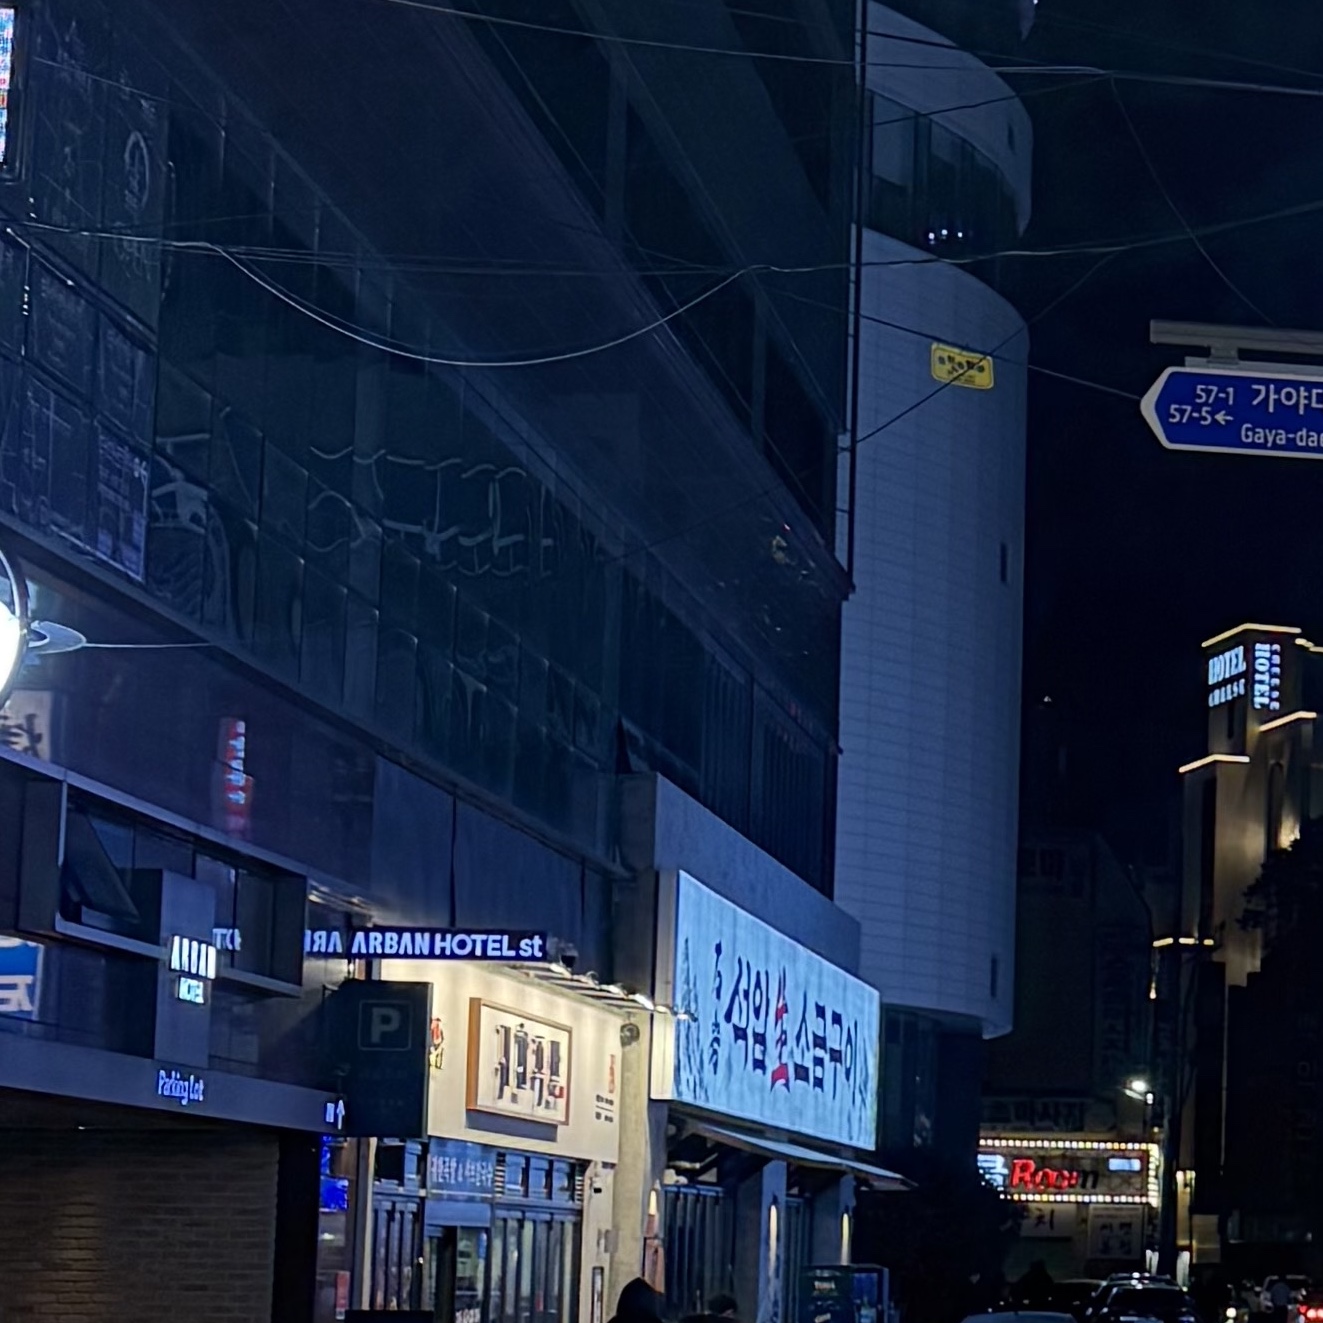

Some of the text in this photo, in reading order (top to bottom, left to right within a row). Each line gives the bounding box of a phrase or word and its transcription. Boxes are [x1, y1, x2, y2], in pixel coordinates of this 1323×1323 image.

[1195, 384, 1234, 405] 57-1
[1168, 405, 1212, 426] 57-5
[1208, 645, 1247, 686] HOTEL
[1253, 643, 1272, 709] HOTEL
[351, 930, 544, 958] ARBAN HOTEL st
[371, 1007, 401, 1044] P
[157, 1069, 205, 1106] Parking Lot
